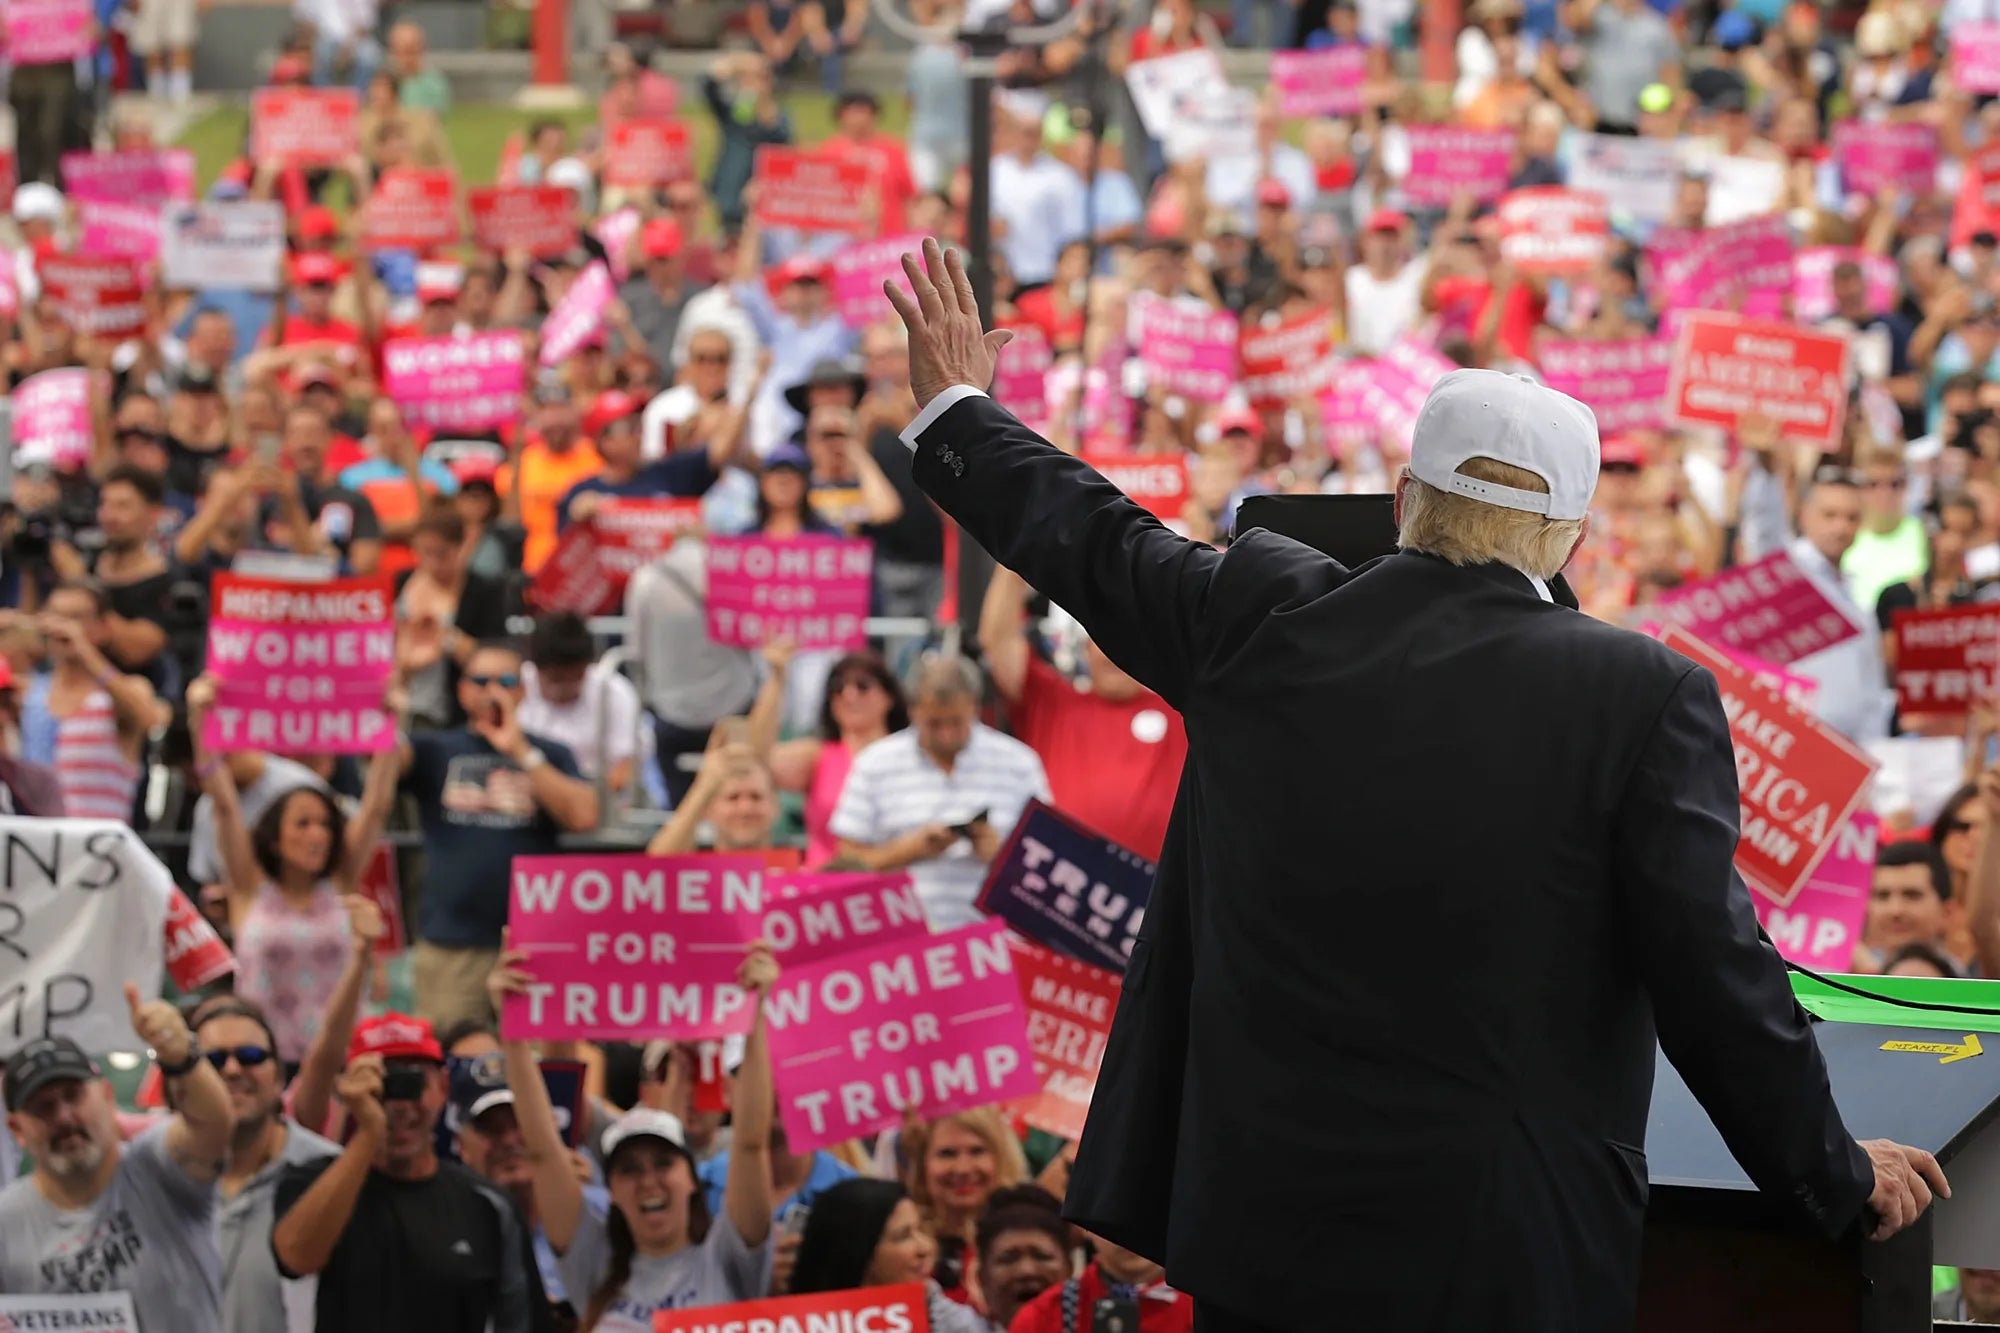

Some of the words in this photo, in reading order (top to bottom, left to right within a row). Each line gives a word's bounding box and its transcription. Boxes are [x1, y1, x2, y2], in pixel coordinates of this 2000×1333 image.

[711, 545, 873, 580] WOMEN
[221, 587, 386, 623] HISPANICS
[752, 584, 816, 611] FOR
[210, 628, 394, 667] WOMEN
[266, 675, 336, 703] FOR
[216, 708, 387, 746] TRUMP
[1736, 742, 1831, 846] RICA
[514, 870, 763, 913] WOMEN
[762, 884, 926, 952] OMEN
[586, 932, 677, 964] FOR
[765, 930, 1013, 1031] WOMEN
[1030, 976, 1110, 1024] MAKE
[525, 982, 748, 1026] TRUMP
[849, 1012, 941, 1060] FOR
[794, 1044, 1020, 1134] TRUMP
[7, 1308, 126, 1329] VETERANS
